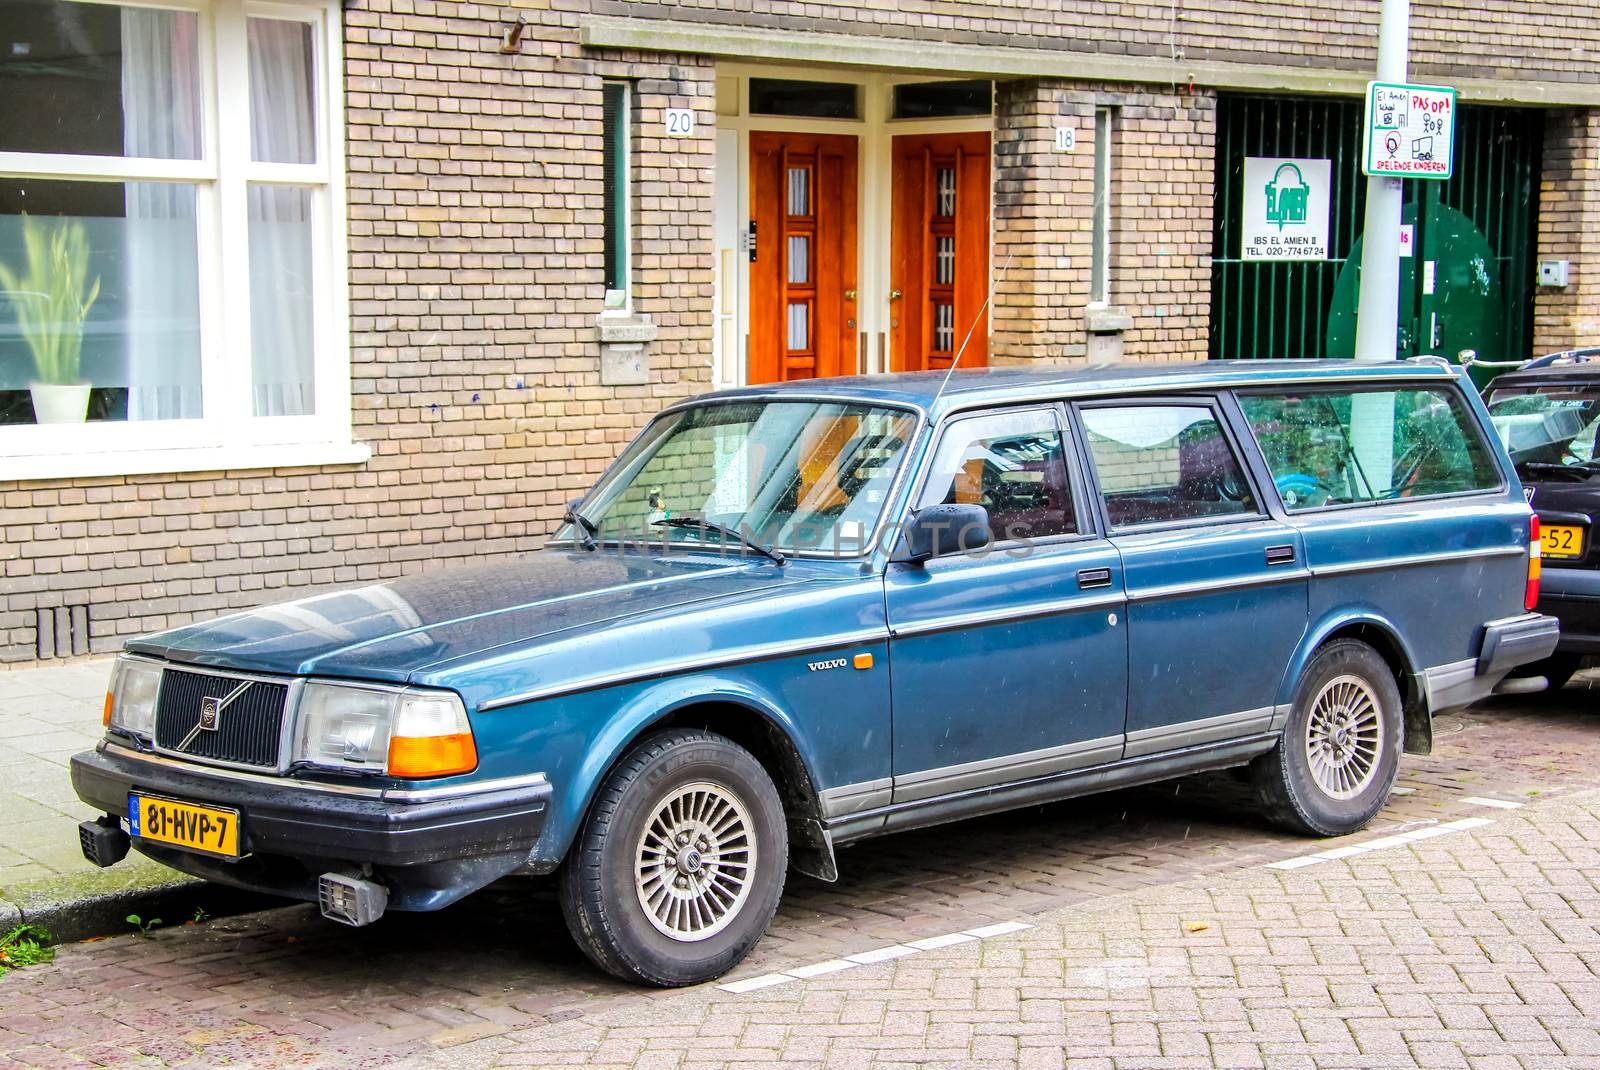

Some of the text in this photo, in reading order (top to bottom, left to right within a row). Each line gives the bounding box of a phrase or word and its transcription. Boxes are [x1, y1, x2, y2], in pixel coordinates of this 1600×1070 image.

[1412, 96, 1450, 113] PAS OP!
[669, 112, 690, 132] 20
[1059, 130, 1073, 148] 18
[1376, 160, 1447, 172] SPELENDE KINDEREN
[1253, 236, 1268, 245] IBS
[1270, 236, 1281, 245] EL
[1283, 236, 1309, 245] AMIEN
[807, 658, 848, 672] VOLVO
[147, 803, 228, 849] 81-HVP-7
